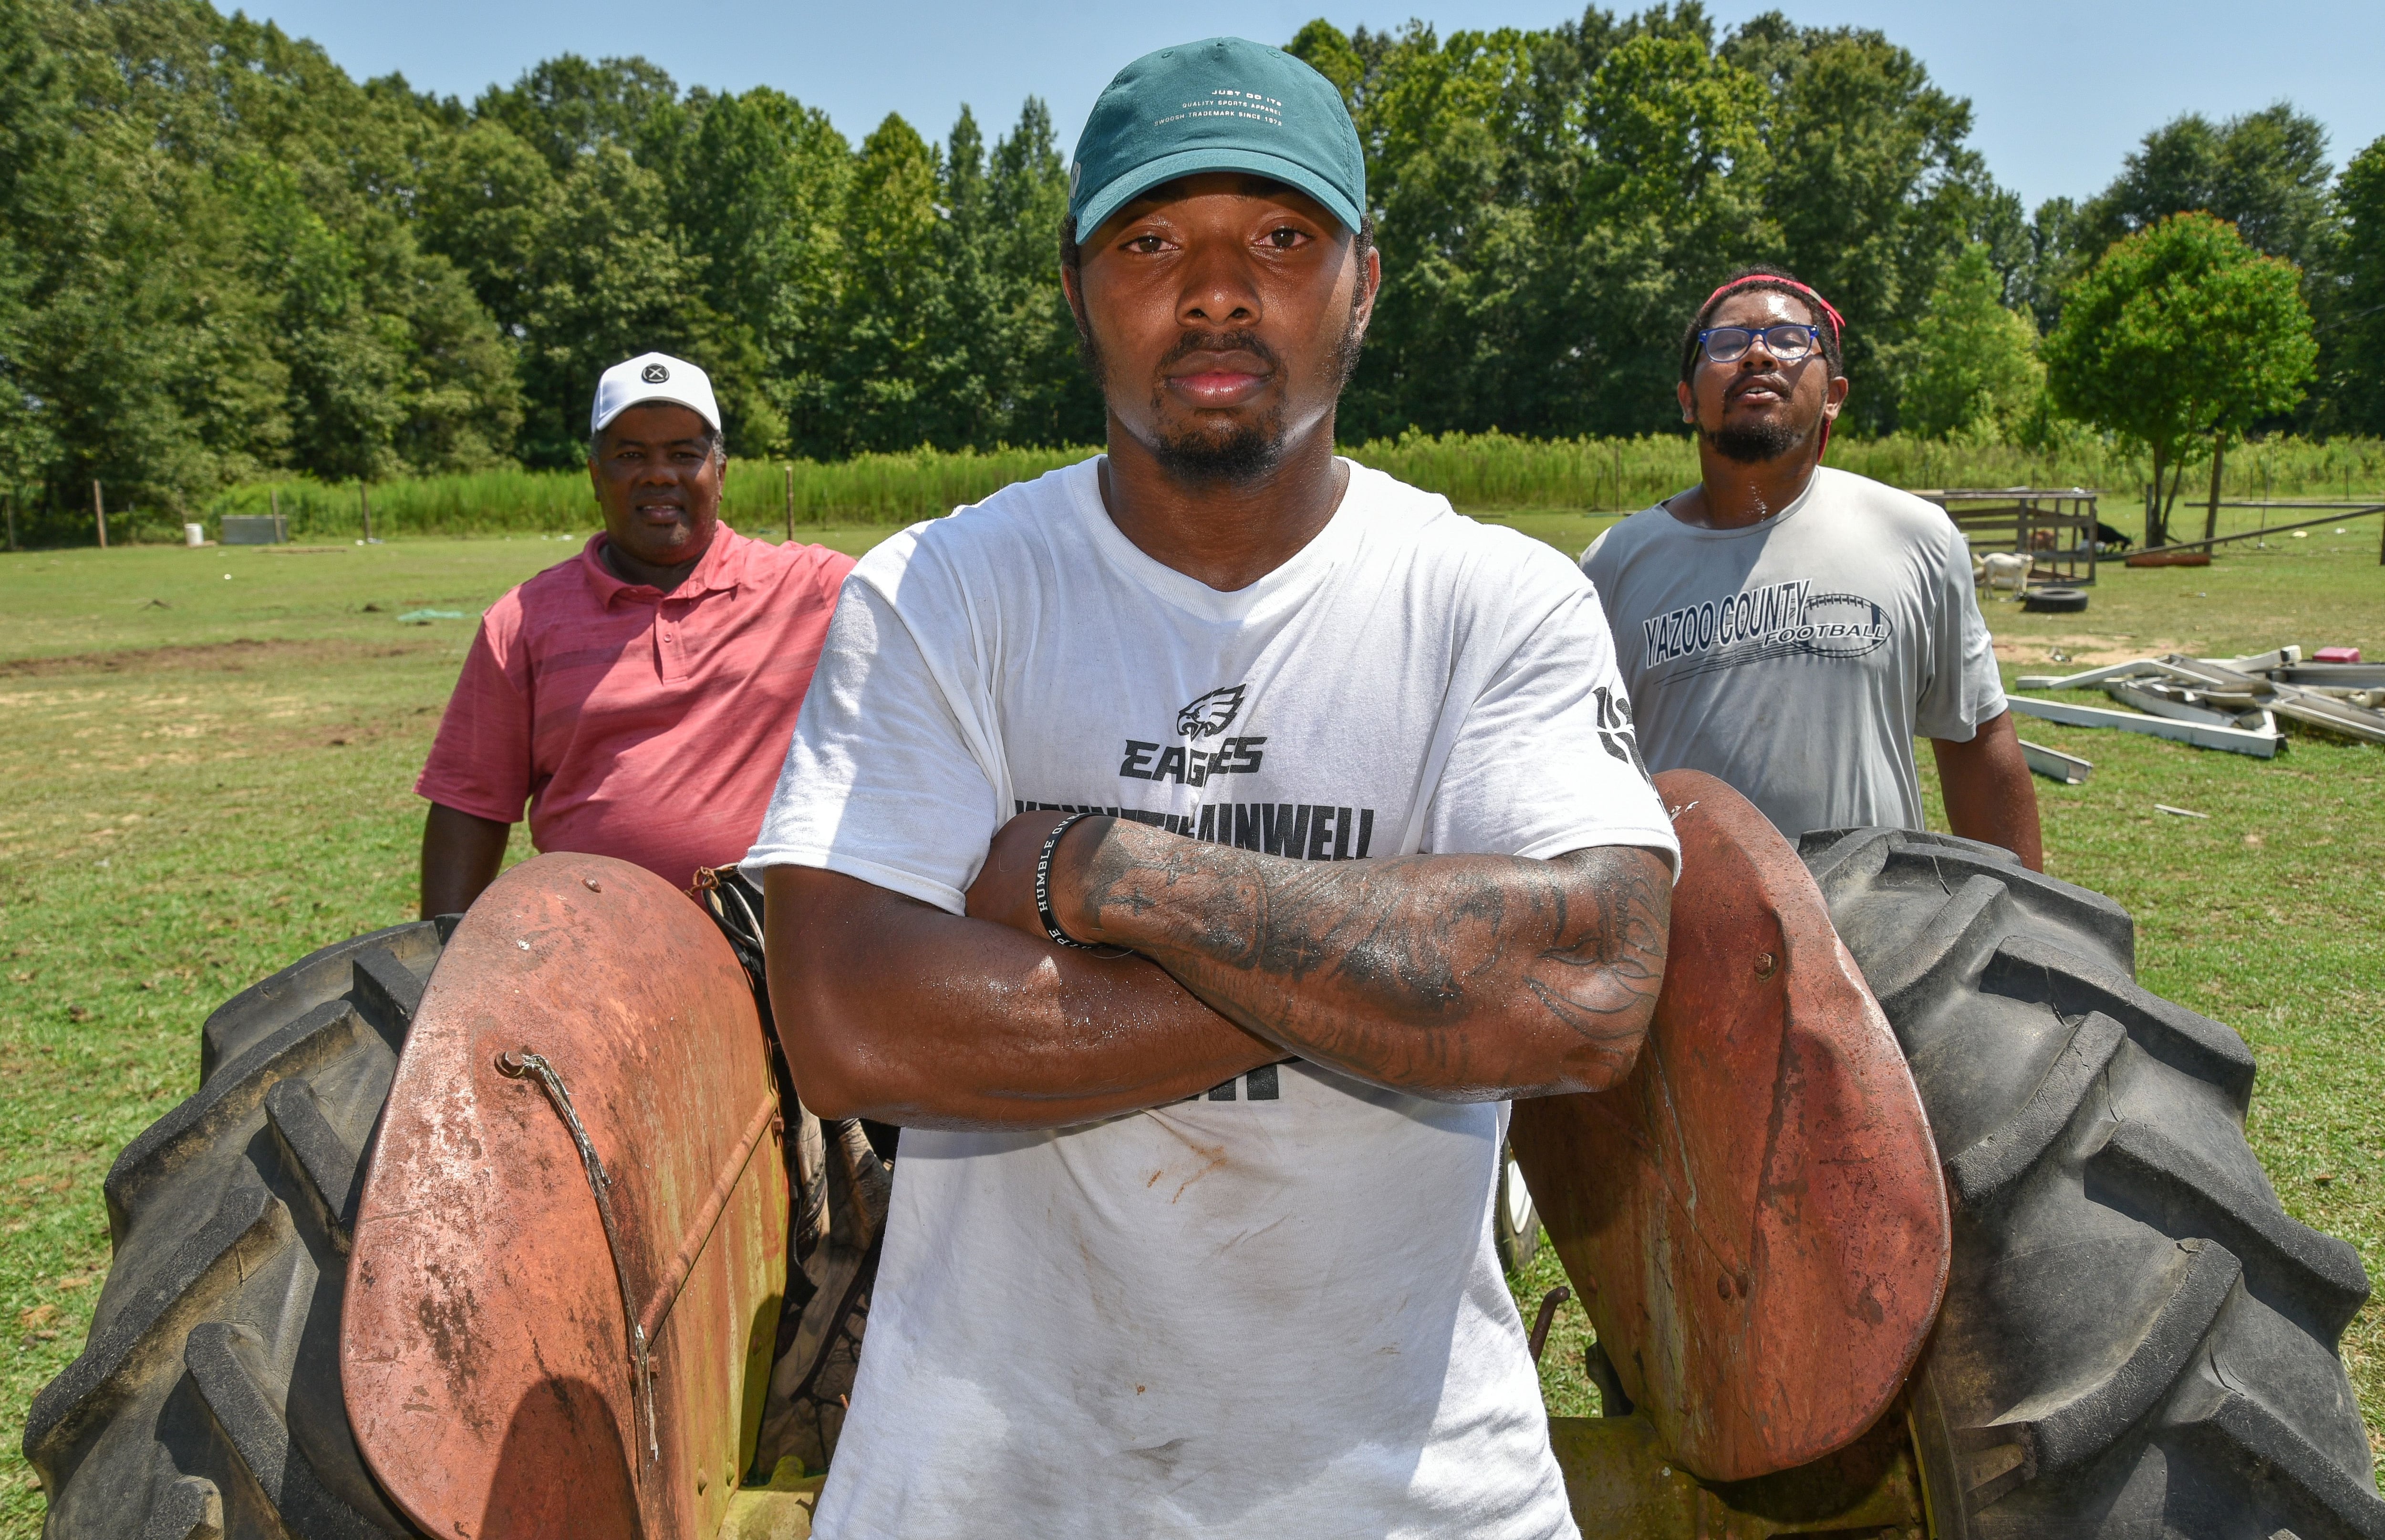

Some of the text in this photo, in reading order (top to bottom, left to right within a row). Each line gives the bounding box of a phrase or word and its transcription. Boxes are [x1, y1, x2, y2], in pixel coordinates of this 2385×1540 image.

[1154, 114, 1184, 126] SWOOSH
[1239, 112, 1260, 120] SINCE
[1265, 116, 1282, 126] 1972
[1182, 100, 1214, 108] QUALITY
[1251, 103, 1282, 116] APPAREL
[1642, 578, 1813, 669] YAZOO COUNTY
[1762, 623, 1888, 648] FOOTBALL
[1120, 736, 1268, 788] EAGLES
[1188, 803, 1374, 860] AINWELL
[1036, 812, 1082, 912] HUMBLE OVE
